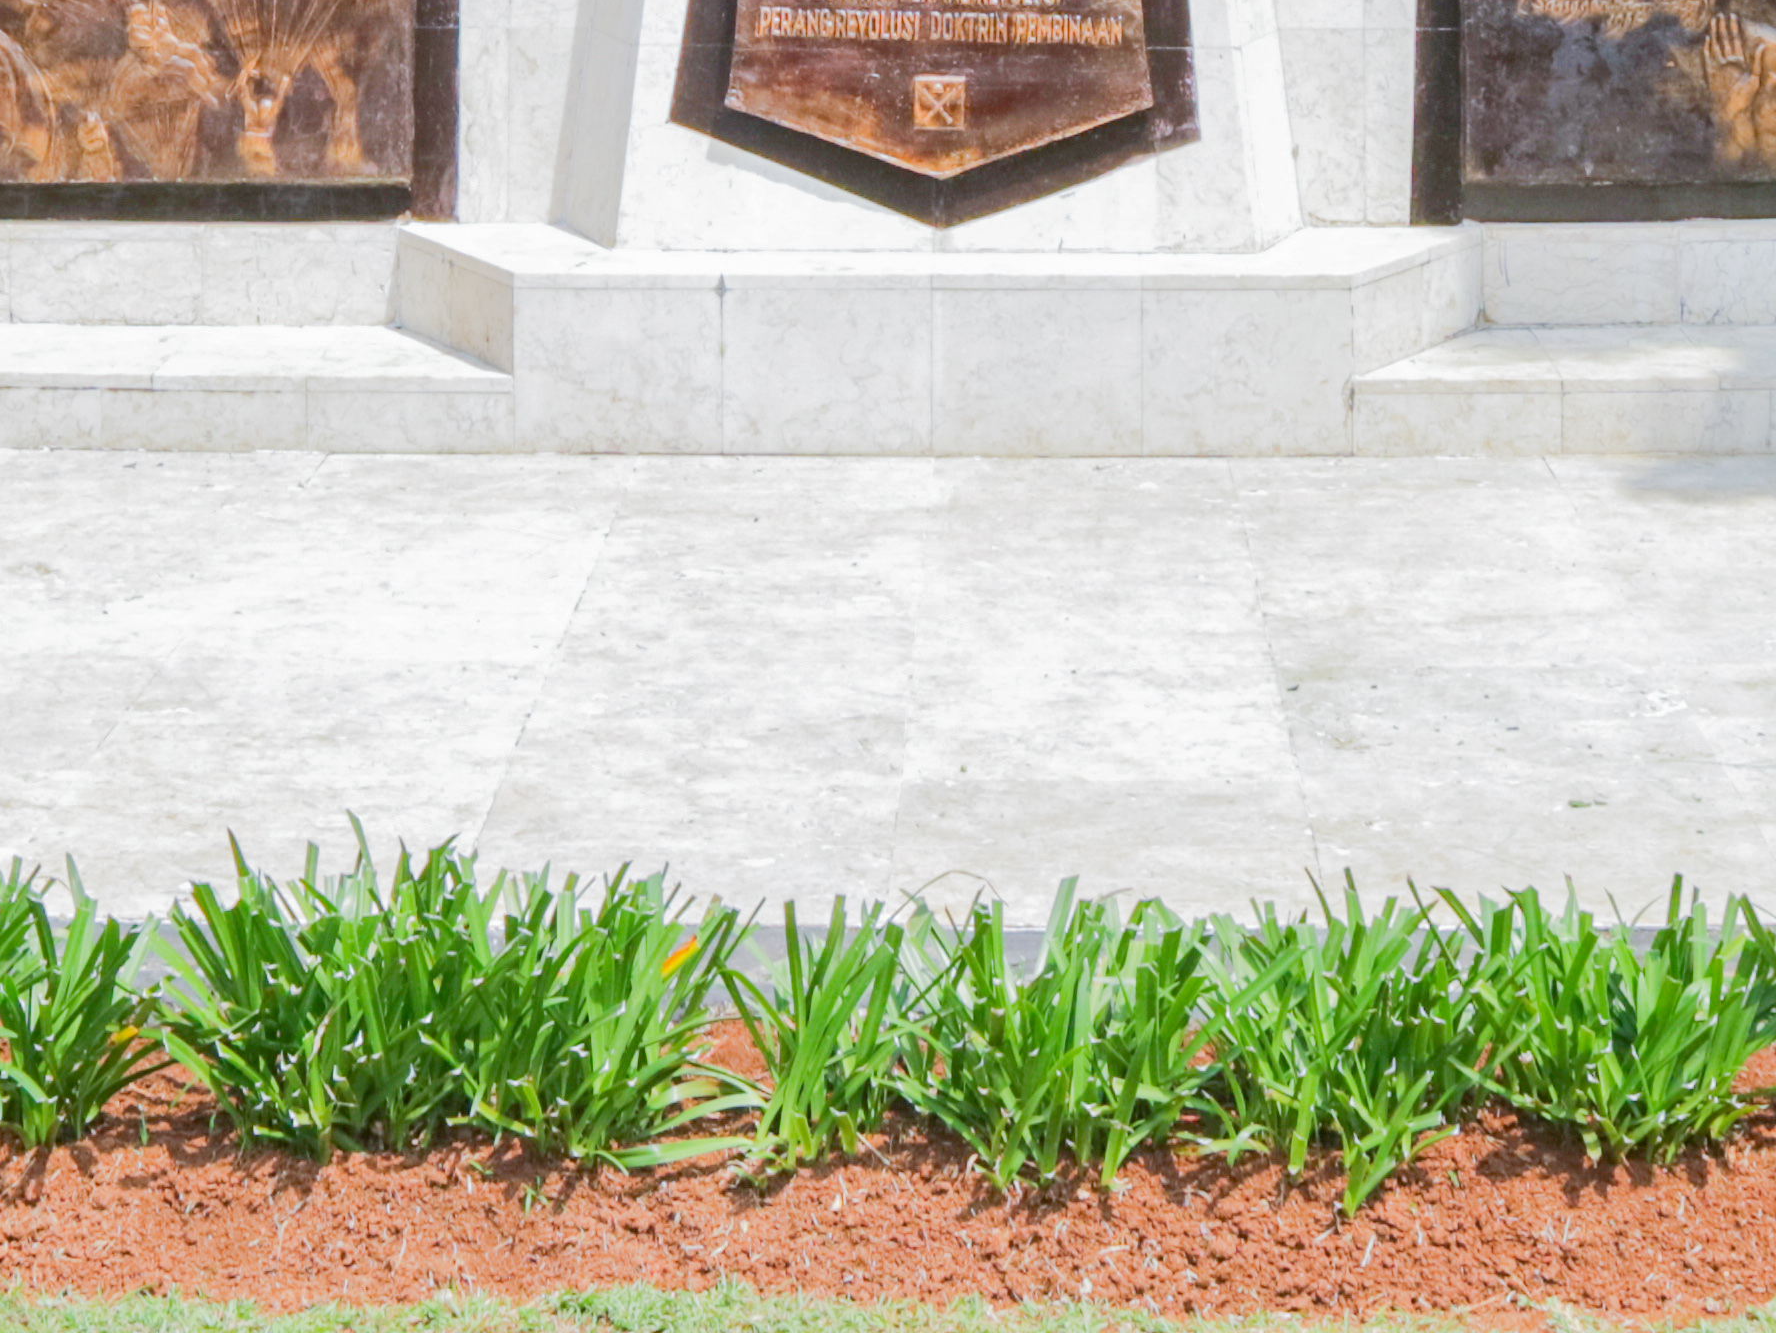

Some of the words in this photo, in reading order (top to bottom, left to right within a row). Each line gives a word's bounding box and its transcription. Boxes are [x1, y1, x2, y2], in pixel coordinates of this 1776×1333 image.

[756, 5, 831, 38] PERANG
[833, 8, 921, 41] REVOLUSI
[929, 10, 1008, 43] DOKTRIN
[1012, 12, 1123, 45] PEMBINAAN
